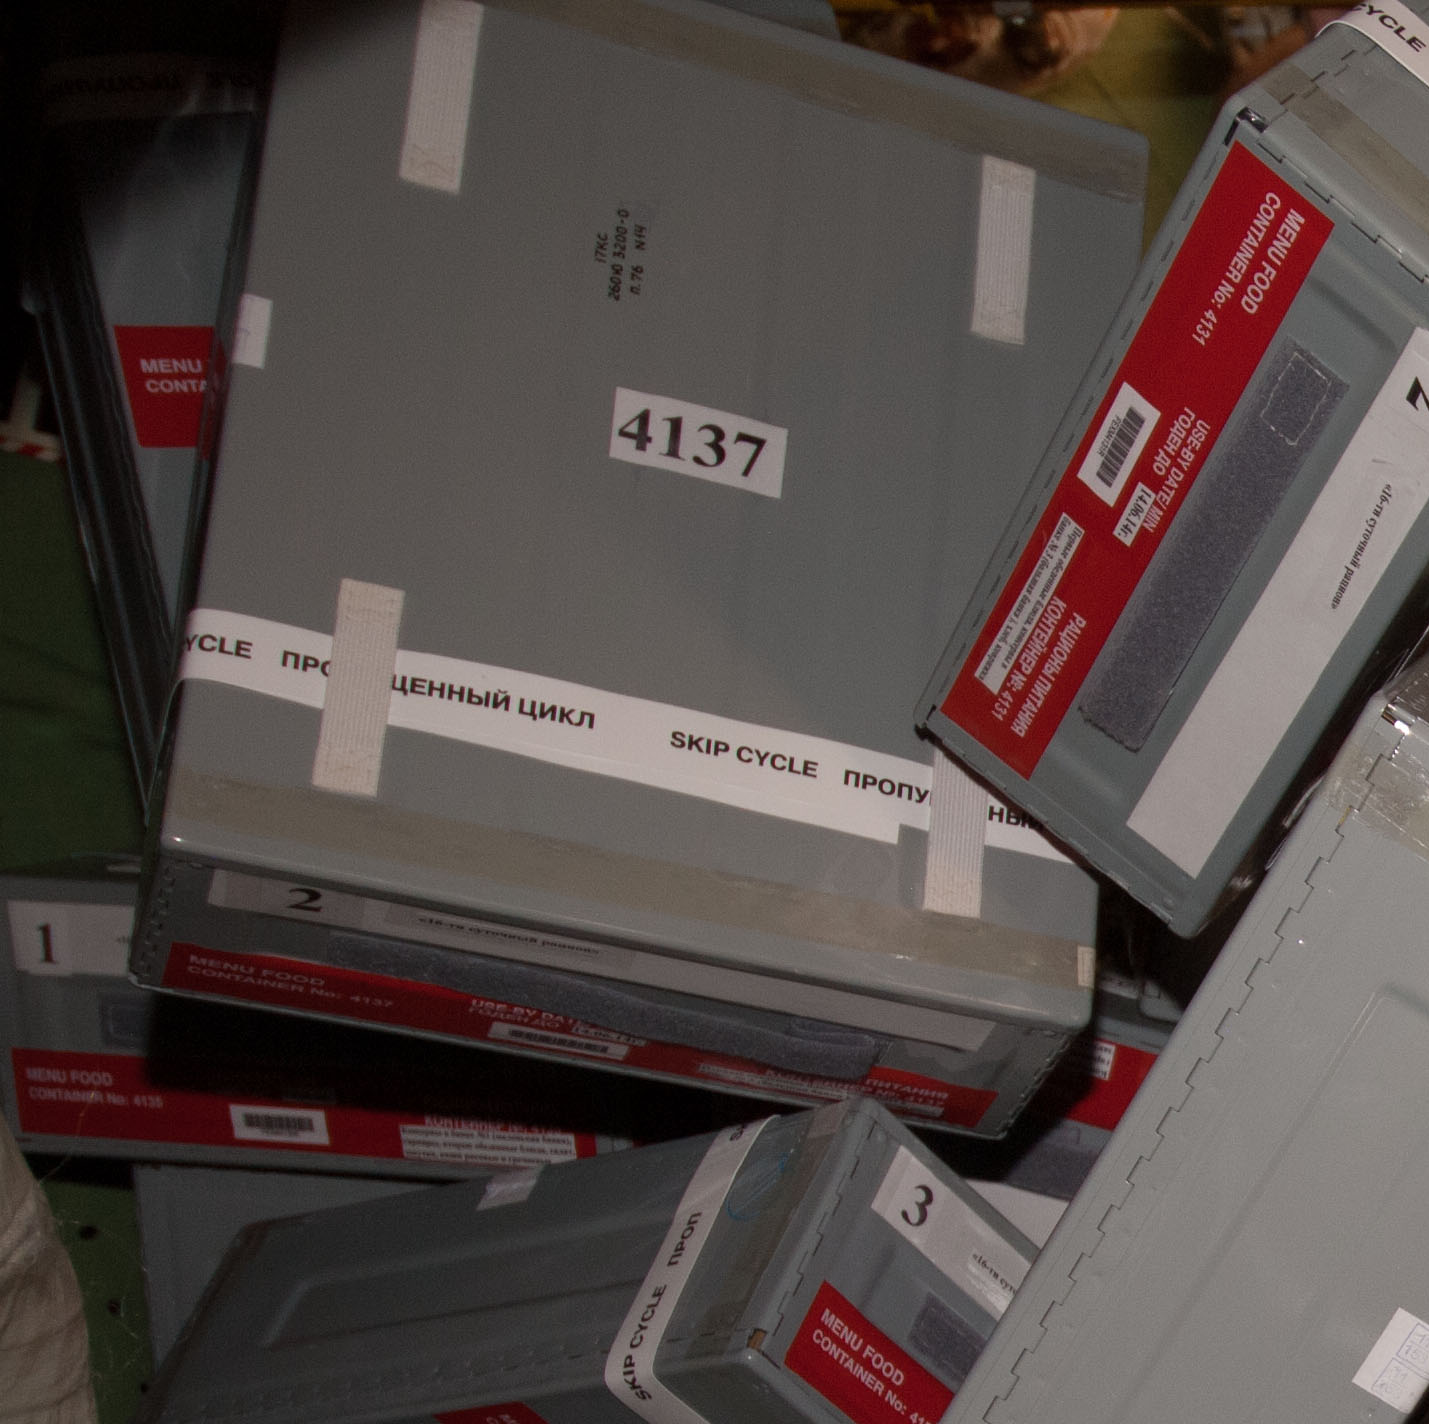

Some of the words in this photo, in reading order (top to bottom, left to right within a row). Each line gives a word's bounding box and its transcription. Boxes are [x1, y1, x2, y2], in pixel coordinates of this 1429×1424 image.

[1221, 189, 1284, 285] CONTAINER
[1262, 206, 1308, 267] MENU
[1211, 280, 1234, 308] No:
[1236, 259, 1279, 316] FOOD
[1192, 309, 1217, 346] 4131
[140, 358, 202, 374] MENU
[618, 409, 767, 477] 4137
[1159, 404, 1198, 454] ГОДЕН
[1177, 420, 1210, 471] USE-BY
[1153, 448, 1171, 476] ДО
[1152, 464, 1186, 511] DATE/
[1372, 484, 1392, 518] «16-ти
[1140, 504, 1164, 534] MIN
[1350, 518, 1377, 569] суточный
[1331, 565, 1354, 610] рацион»
[1013, 593, 1072, 678] КОНТЕЙНЕР
[1036, 608, 1090, 683] РАЦИОНЫ
[518, 698, 595, 729] ЦИКЛ
[992, 690, 1013, 721] 4131
[1007, 673, 1054, 740] ПИТАНИЯ
[670, 731, 730, 756] SKIP
[736, 746, 818, 778] CYCLE
[287, 888, 322, 912] 2
[39, 924, 55, 964] 1
[190, 954, 255, 974] MENU
[262, 969, 325, 986] FOOD
[24, 1065, 68, 1084] MENU
[68, 1068, 114, 1088] FOOD
[901, 1185, 934, 1227] 3
[630, 1284, 667, 1349] CYCLE
[821, 1308, 863, 1351] MENU
[862, 1344, 904, 1386] FOOD
[623, 1354, 652, 1400] SKIP
[812, 1329, 890, 1396] CONTAINER
[884, 1390, 907, 1415] No:
